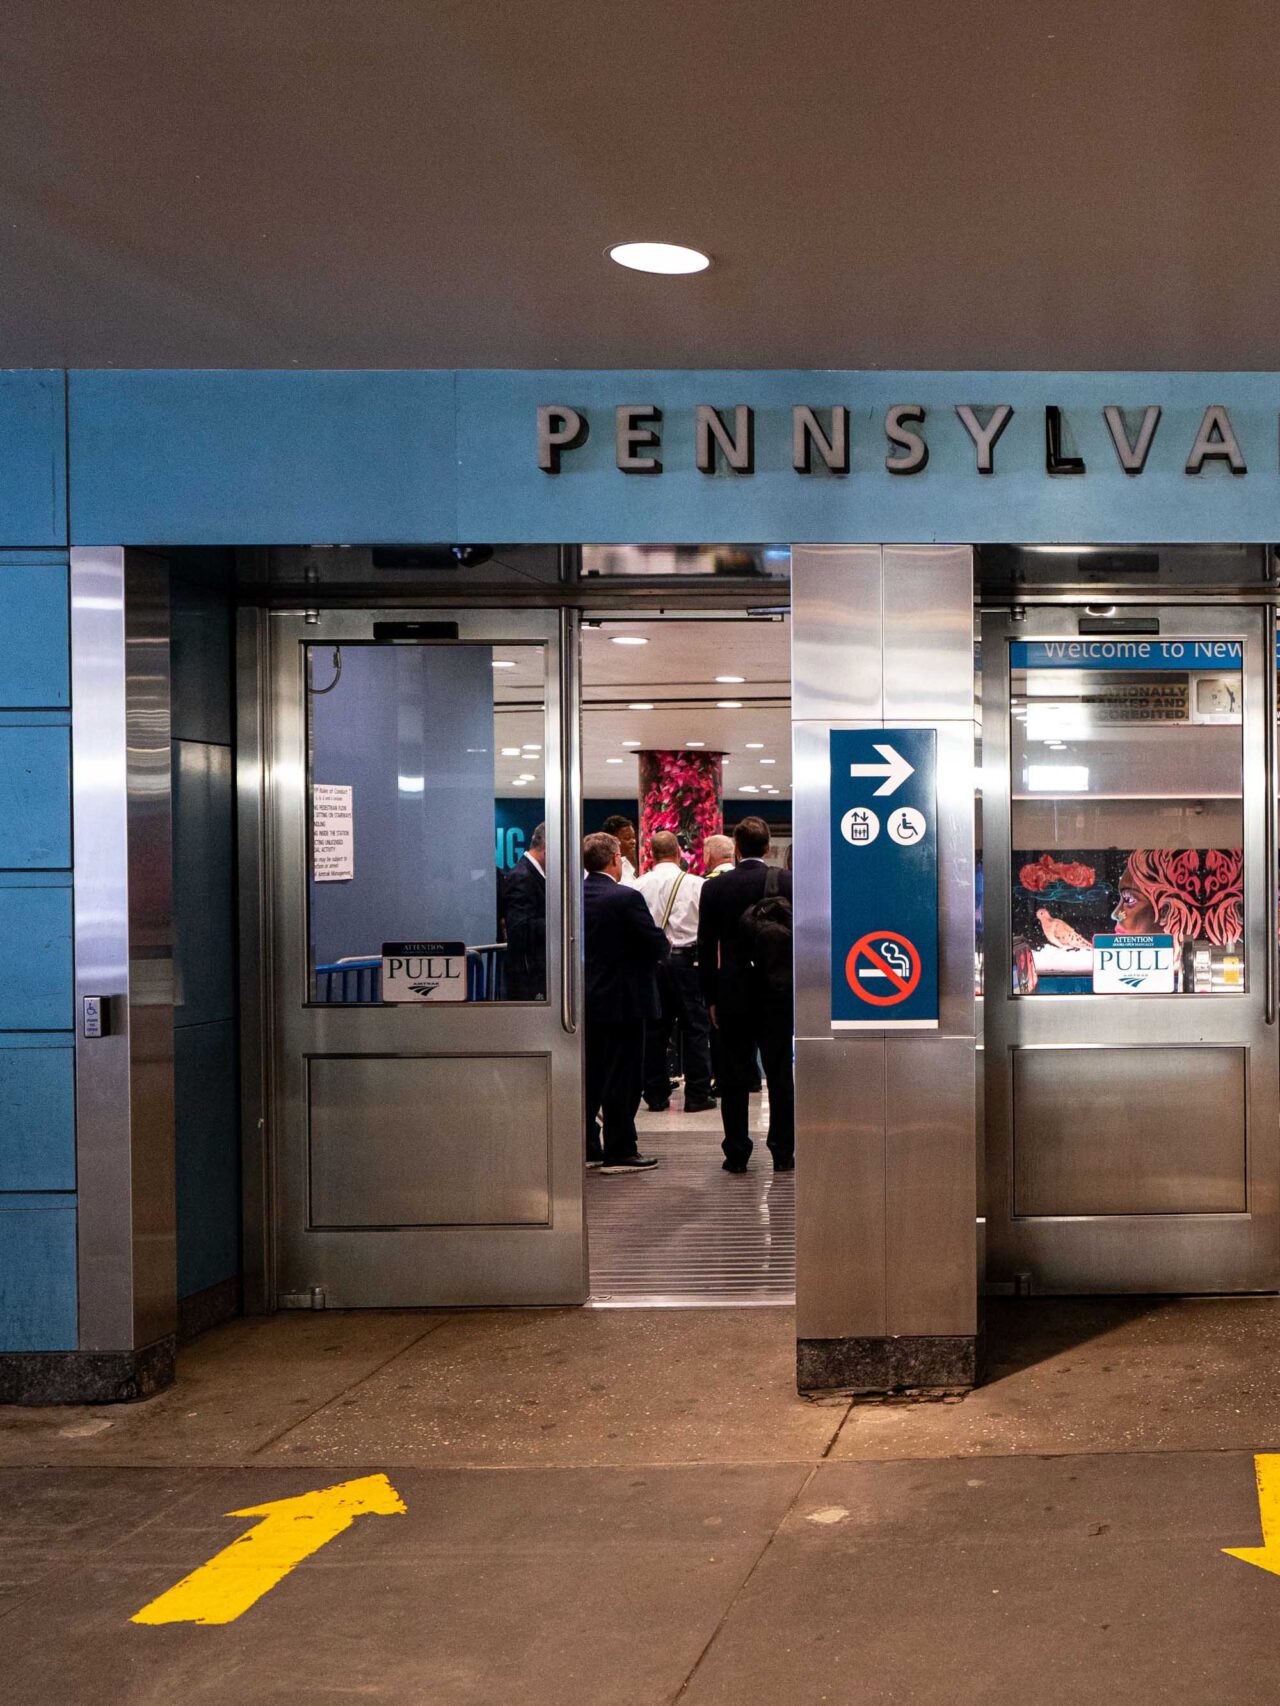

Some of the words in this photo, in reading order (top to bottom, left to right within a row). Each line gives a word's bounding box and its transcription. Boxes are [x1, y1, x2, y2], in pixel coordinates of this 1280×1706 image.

[1044, 642, 1151, 658] Welcome
[1161, 642, 1185, 658] to
[1194, 642, 1242, 658] New
[1097, 686, 1187, 697] ATIONALLY
[1155, 698, 1186, 708] AND
[387, 958, 461, 979] PULL
[1099, 950, 1170, 971] PULL
